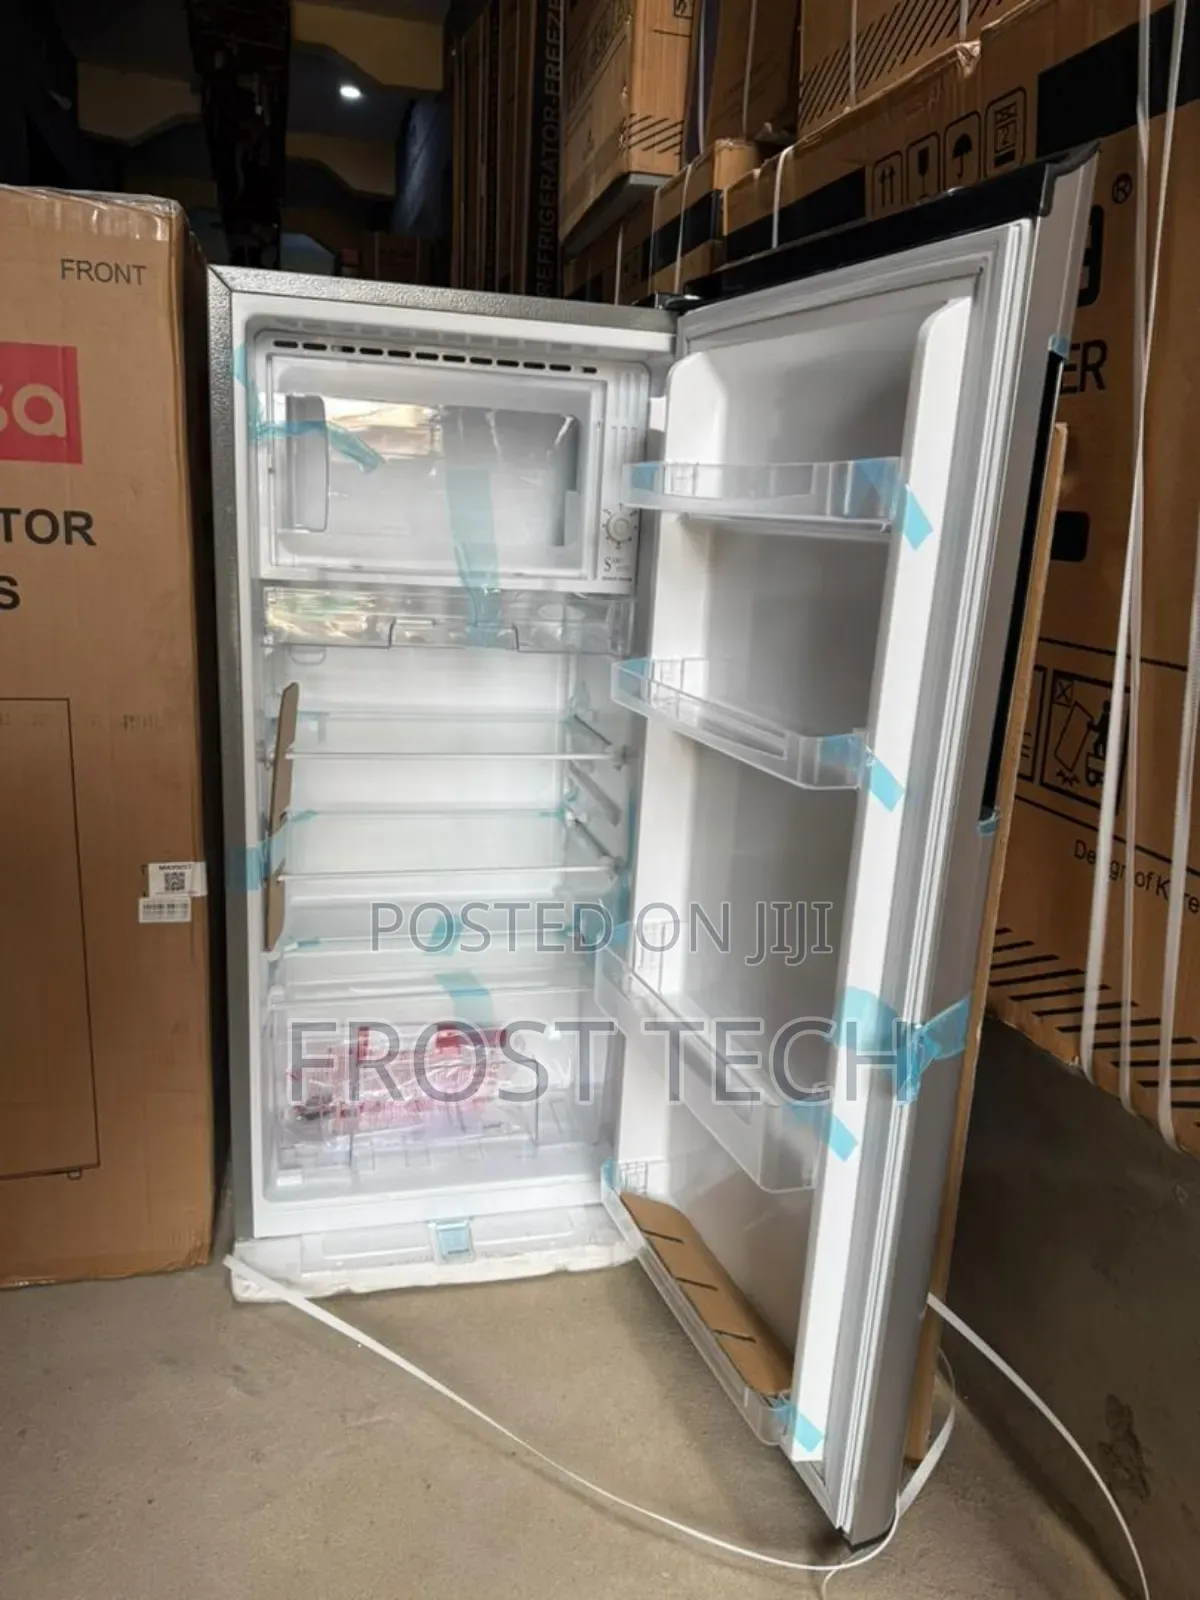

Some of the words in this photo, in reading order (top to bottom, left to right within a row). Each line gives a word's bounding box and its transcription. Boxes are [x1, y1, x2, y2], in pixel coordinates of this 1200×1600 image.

[60, 259, 147, 286] FRONT
[0, 508, 97, 547] TOR
[1134, 870, 1154, 890] of
